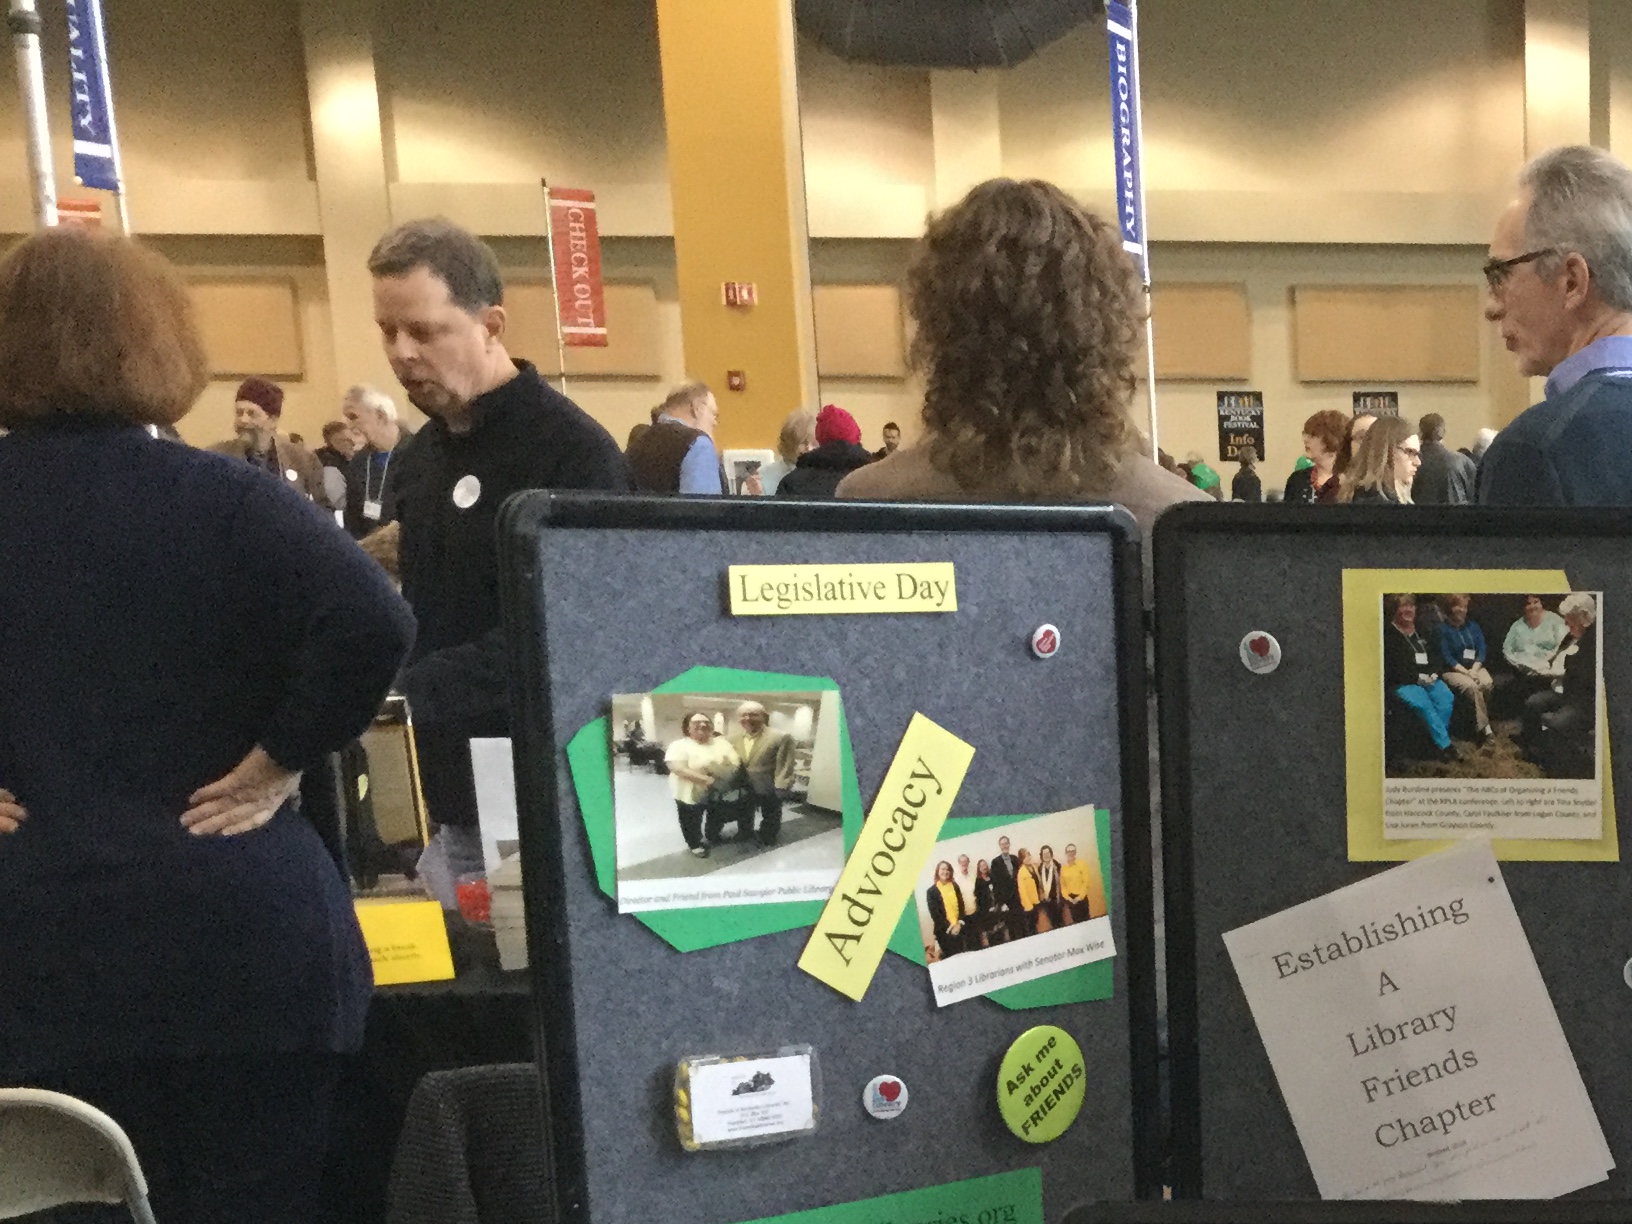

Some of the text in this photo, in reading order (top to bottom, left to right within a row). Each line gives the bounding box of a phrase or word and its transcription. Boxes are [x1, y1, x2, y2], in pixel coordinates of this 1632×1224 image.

[1115, 40, 1136, 238] BIOGRAPHY
[567, 208, 595, 328] CHECK OUT
[1230, 433, 1255, 446] Info
[739, 572, 950, 610] Legislative Day
[823, 756, 943, 968] Advocacy
[1272, 897, 1469, 979] Establishing
[937, 940, 1105, 994] Region 3 Librarians with Senator Max Wise
[1378, 971, 1400, 996] A
[1346, 1005, 1458, 1057] Library
[1006, 1036, 1057, 1096] Ask me
[1023, 1058, 1063, 1107] about
[1360, 1048, 1479, 1104] Friends
[1021, 1063, 1083, 1136] FRIENDS
[1374, 1091, 1497, 1149] Chapter
